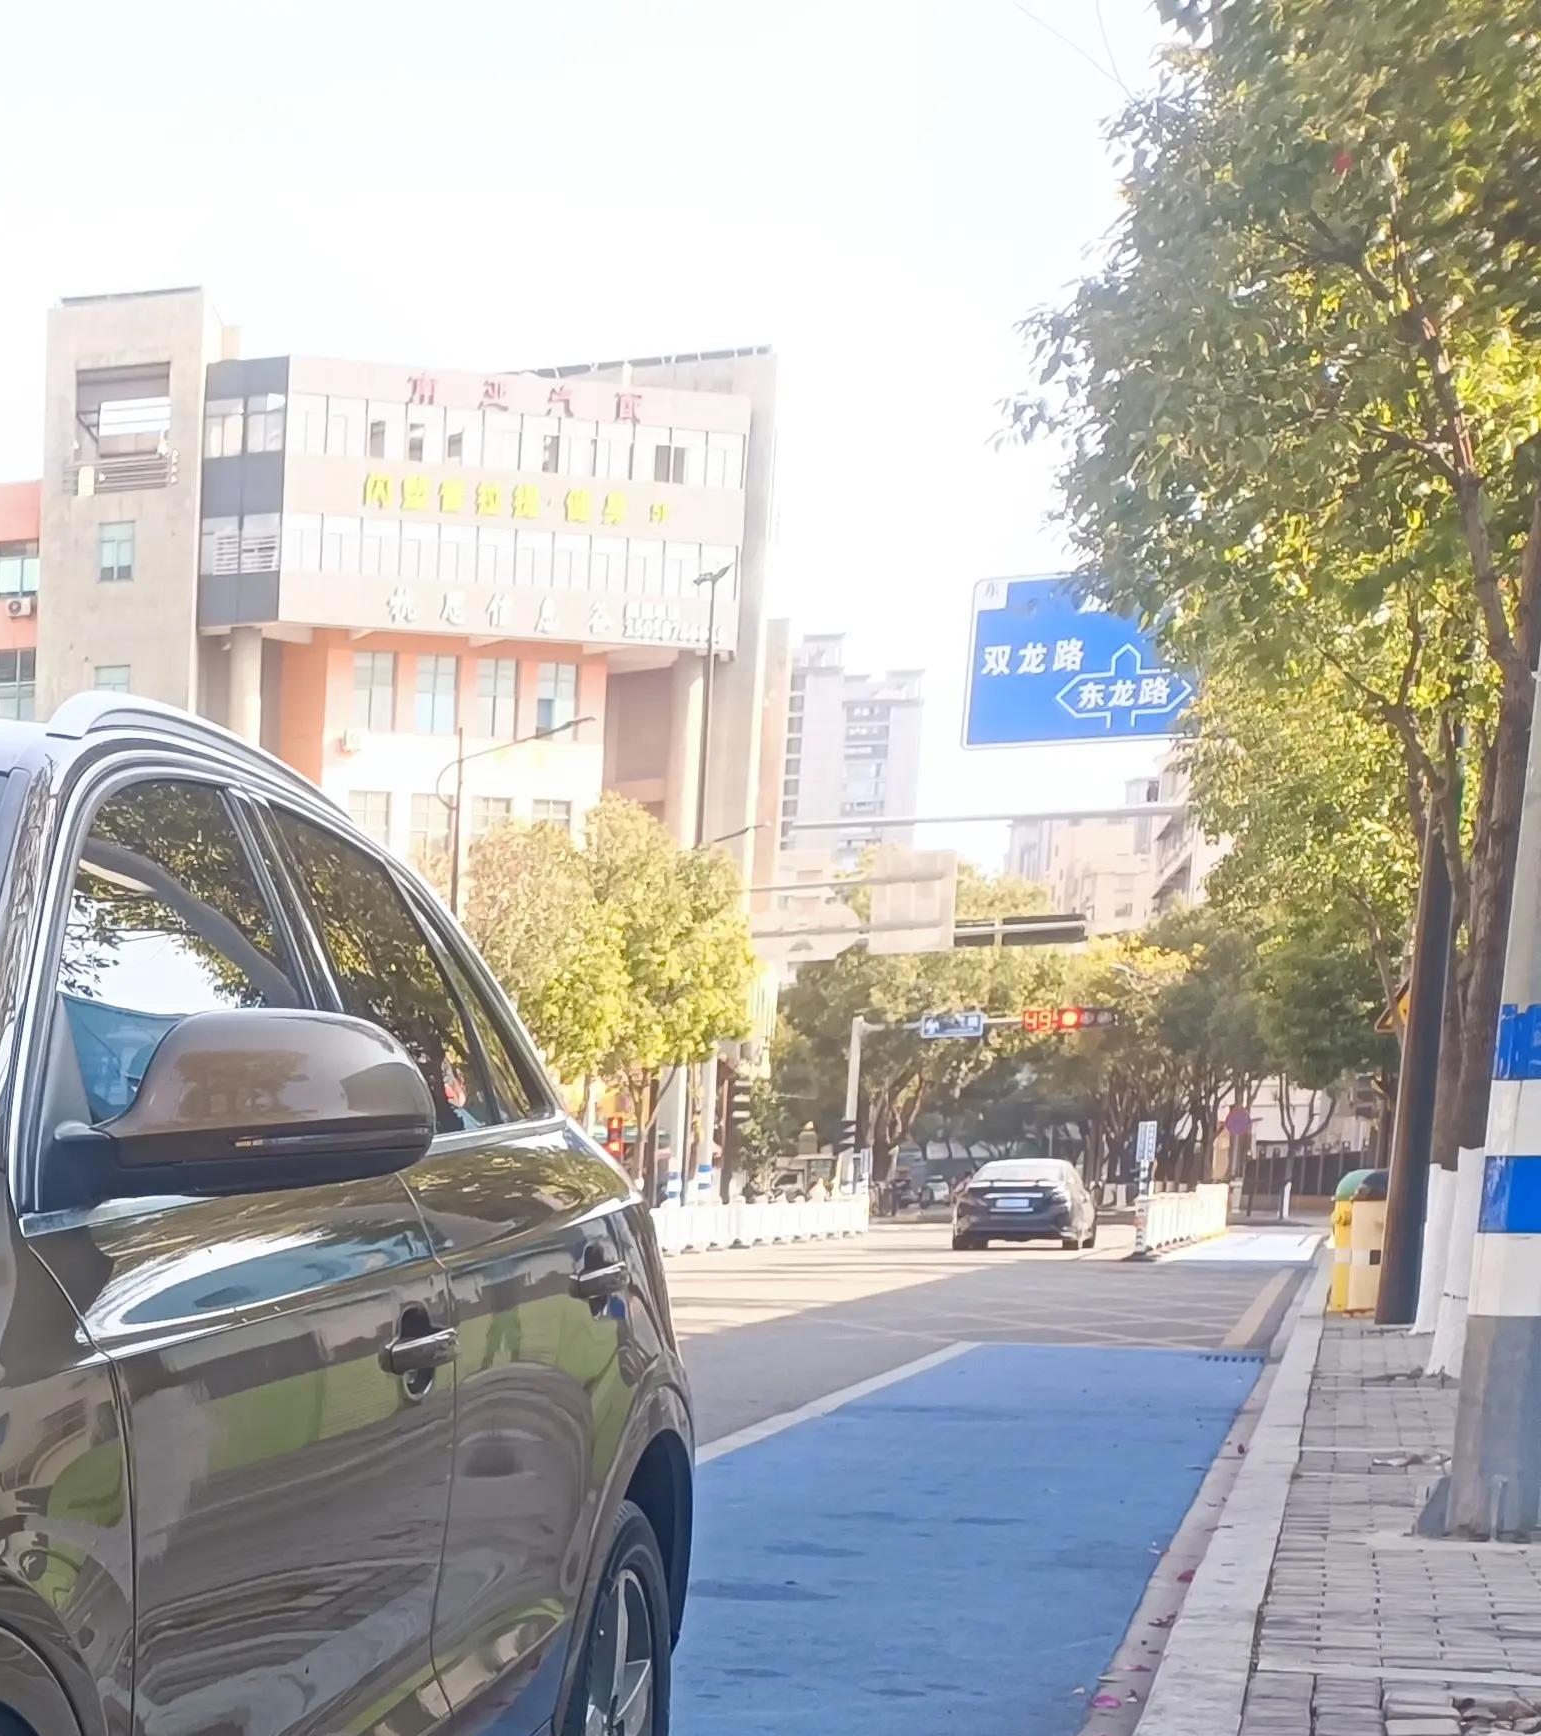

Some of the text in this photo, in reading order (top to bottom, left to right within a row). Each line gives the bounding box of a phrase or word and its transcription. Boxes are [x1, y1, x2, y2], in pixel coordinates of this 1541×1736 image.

[980, 637, 1084, 676] 双龙路
[1077, 676, 1170, 708] 东龙路
[1024, 1010, 1052, 1031] 49
